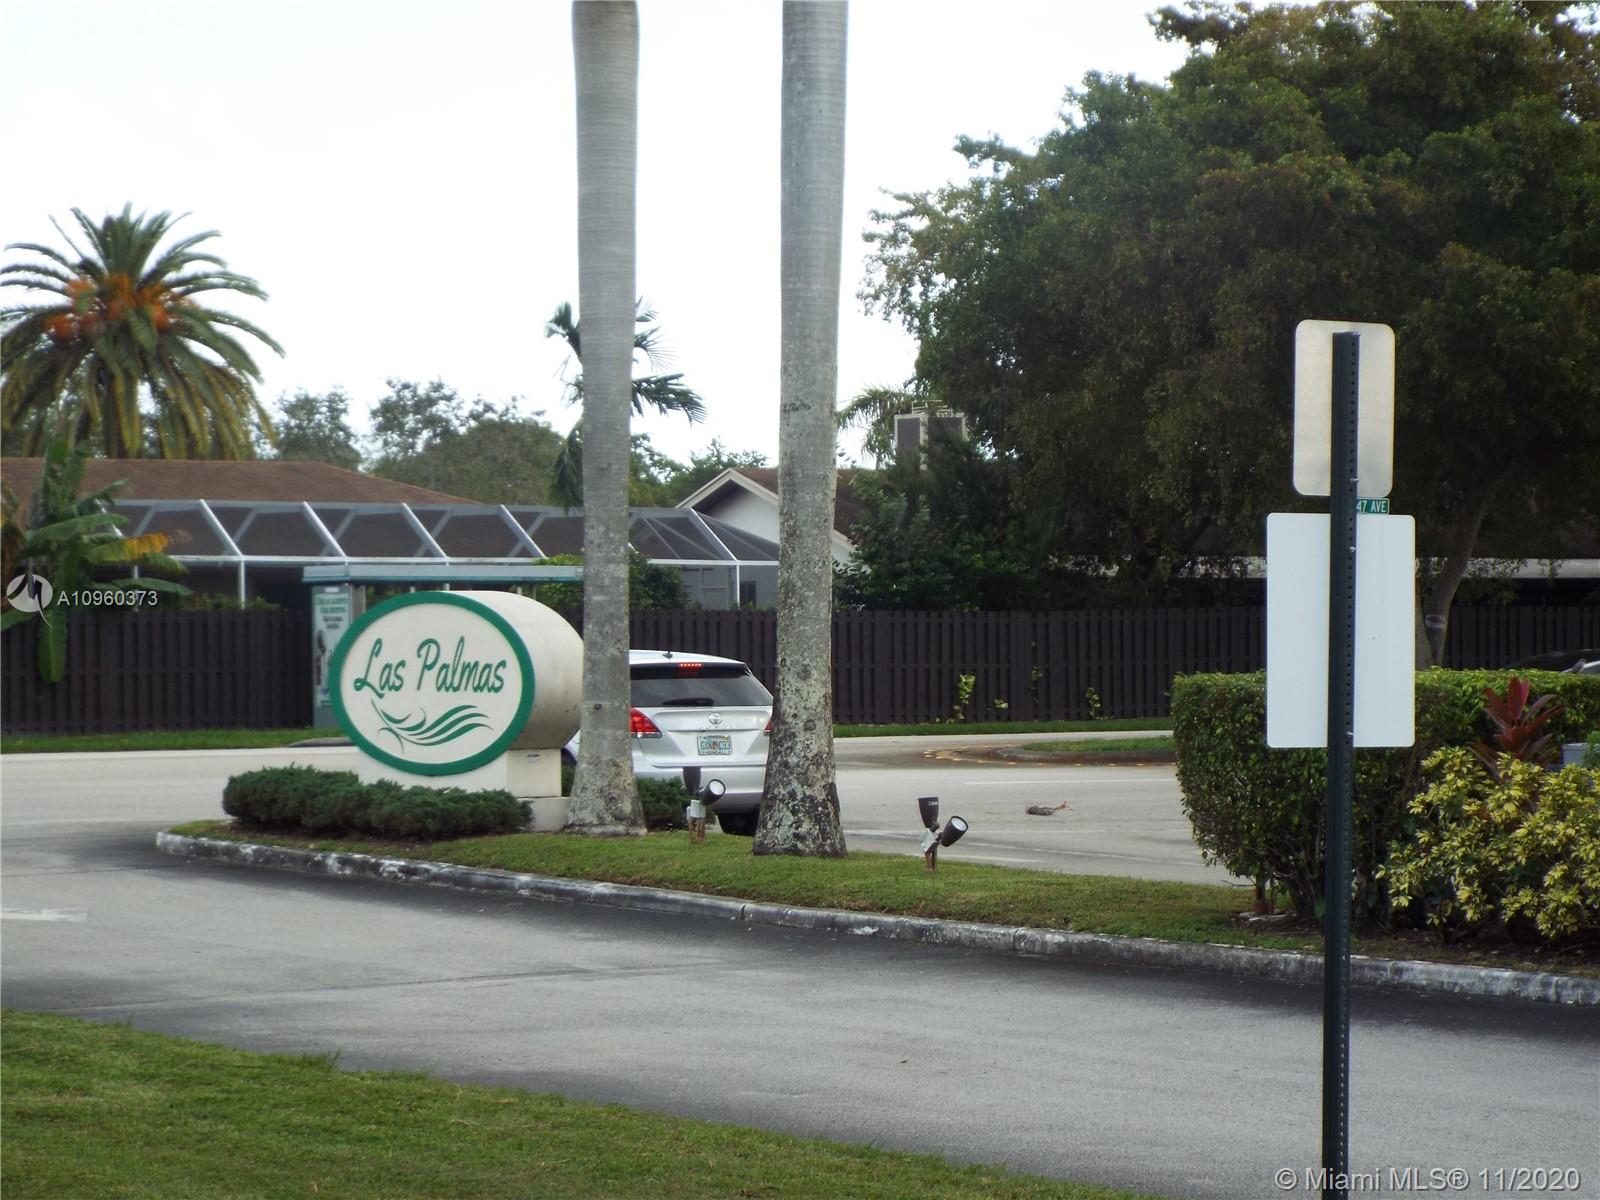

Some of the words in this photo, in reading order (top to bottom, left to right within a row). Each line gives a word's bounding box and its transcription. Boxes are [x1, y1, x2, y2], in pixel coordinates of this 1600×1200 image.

[1370, 500, 1387, 512] AVE
[353, 638, 406, 699] Las
[417, 636, 507, 693] Palmas
